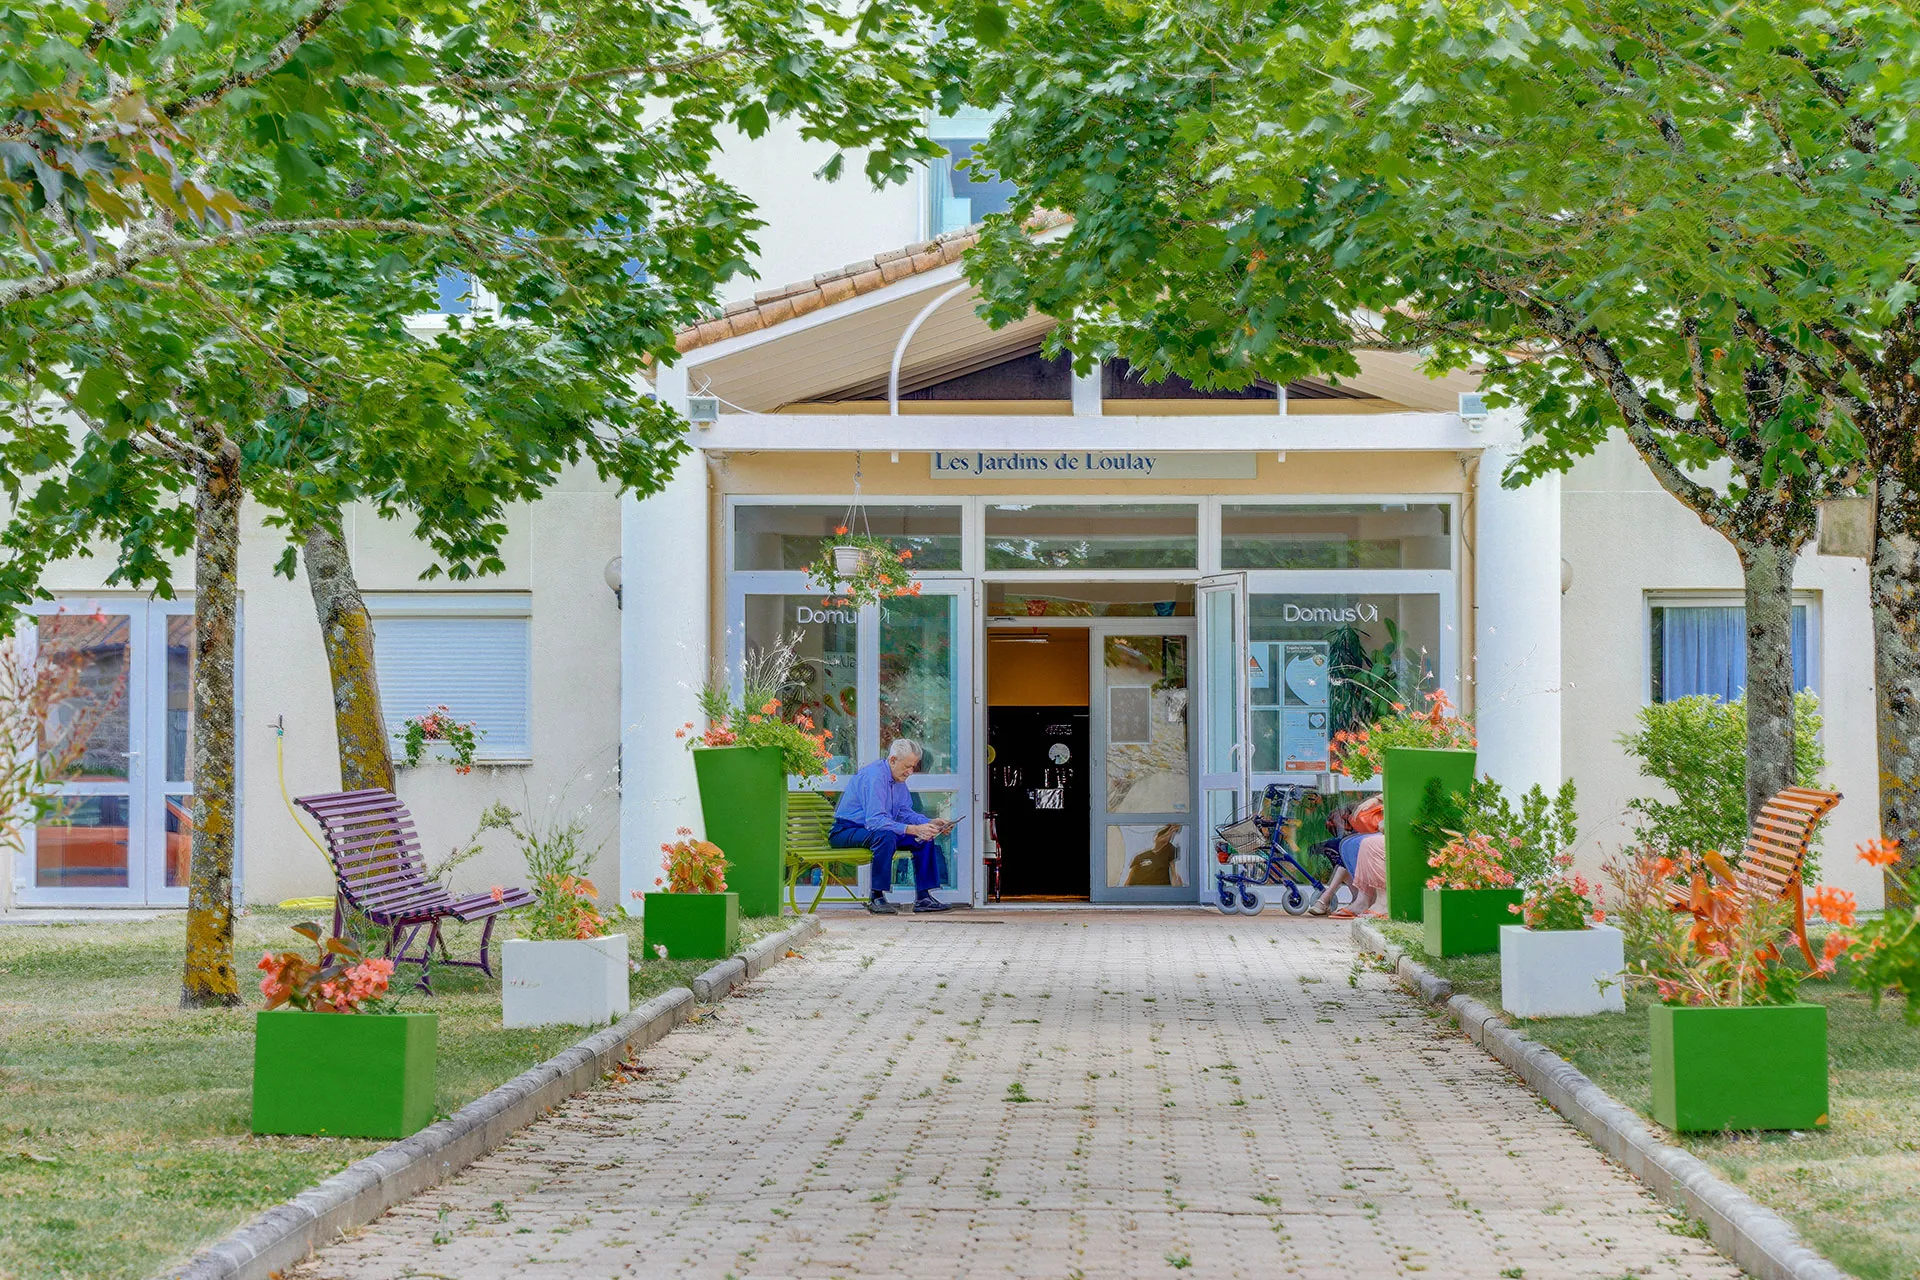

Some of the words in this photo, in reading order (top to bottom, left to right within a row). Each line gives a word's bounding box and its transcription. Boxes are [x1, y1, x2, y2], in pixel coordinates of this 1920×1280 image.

[935, 451, 969, 470] Les
[973, 451, 1048, 475] Jardins
[1054, 452, 1079, 470] de
[1085, 451, 1157, 475] Loulay
[1283, 602, 1378, 623] DomusVi
